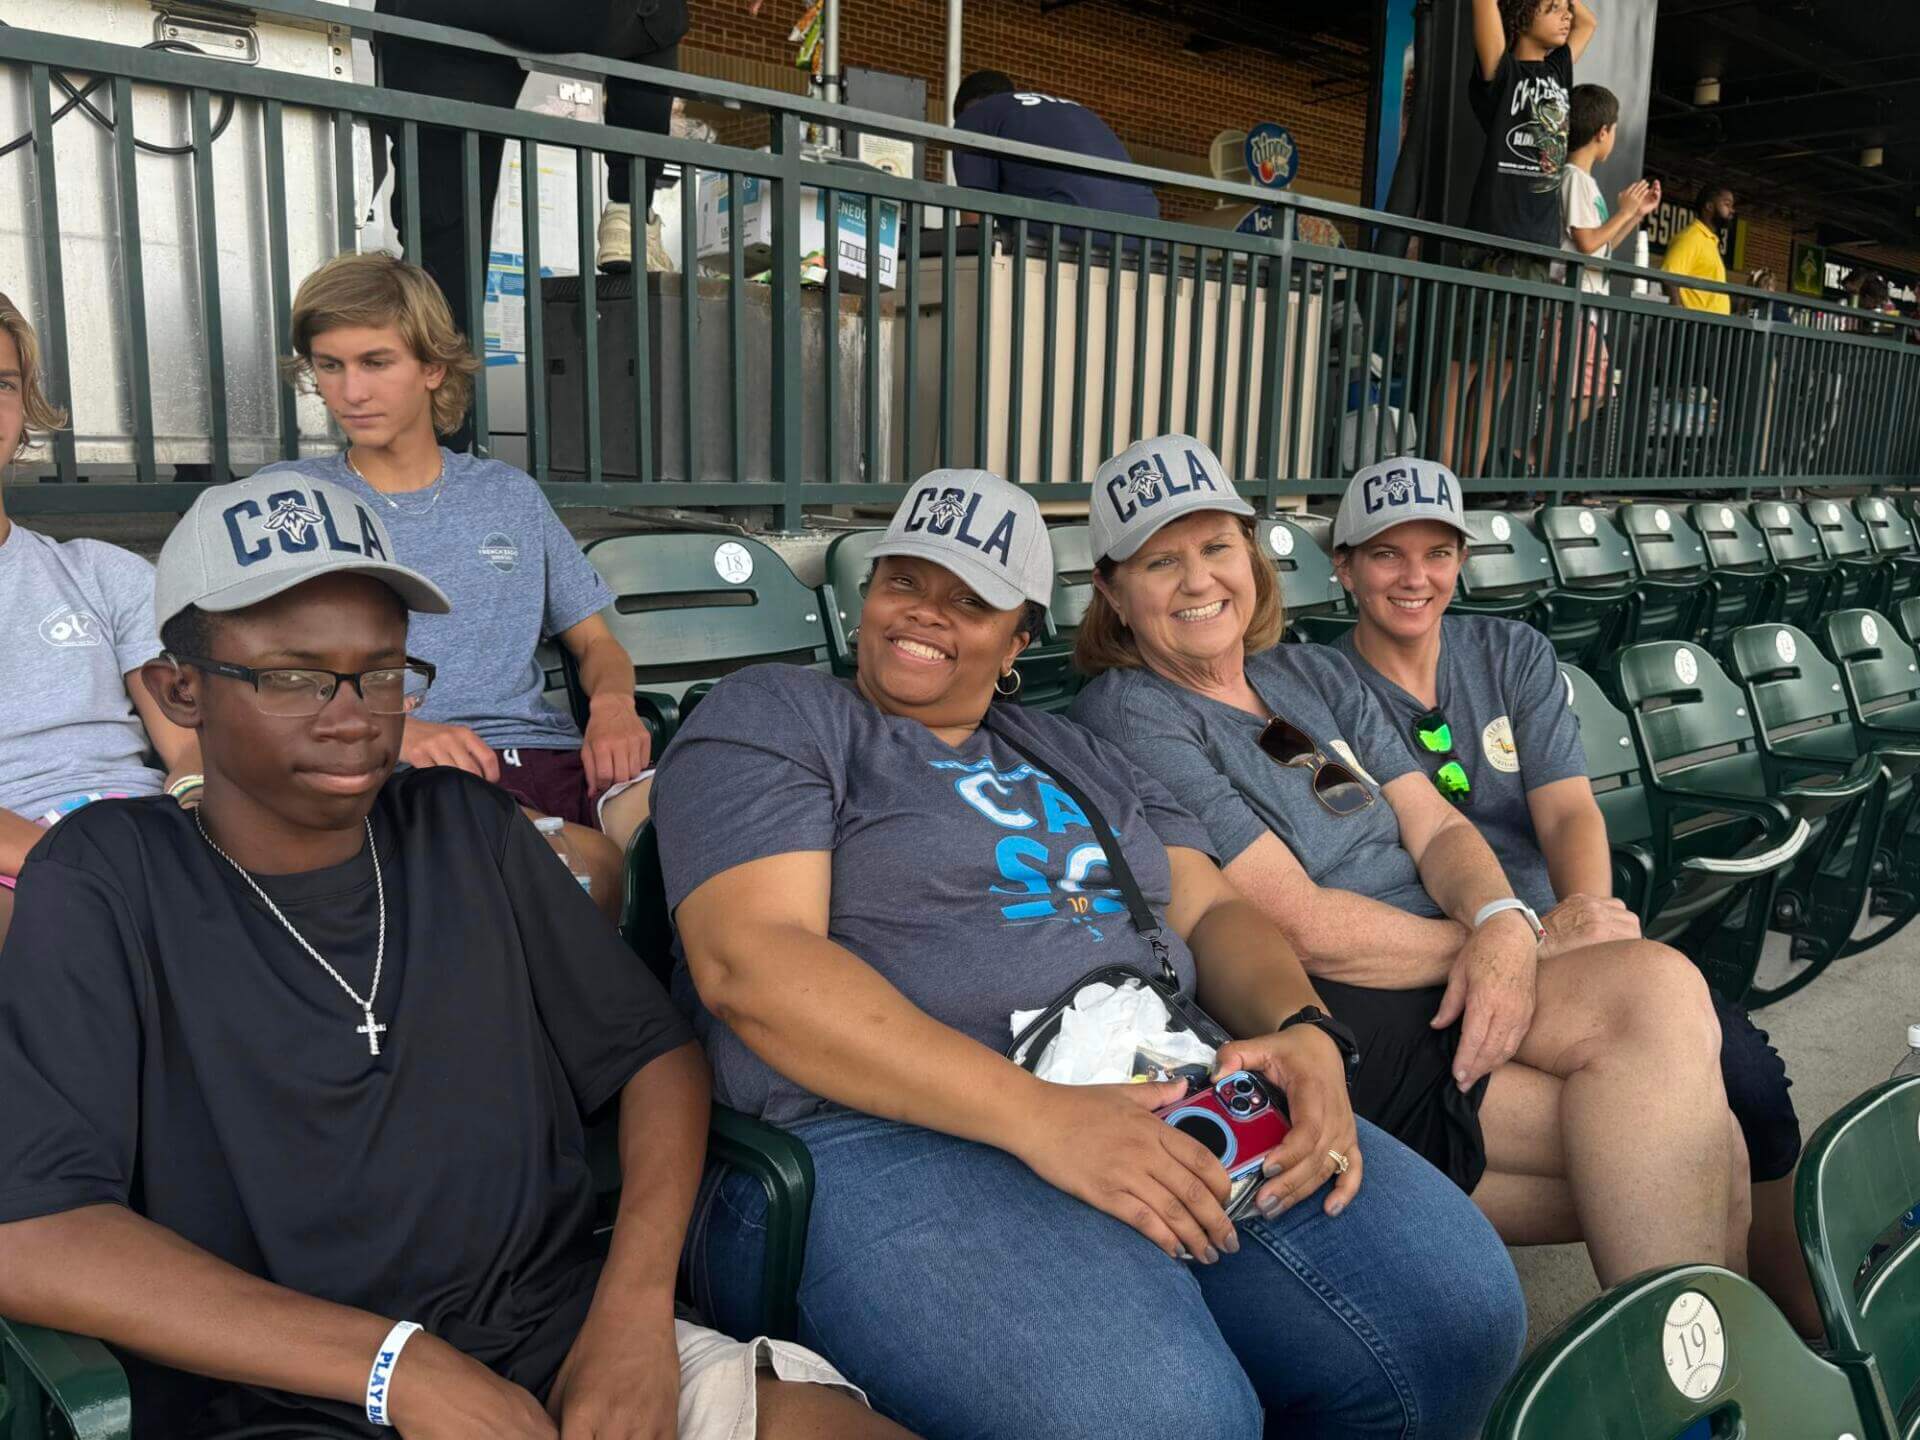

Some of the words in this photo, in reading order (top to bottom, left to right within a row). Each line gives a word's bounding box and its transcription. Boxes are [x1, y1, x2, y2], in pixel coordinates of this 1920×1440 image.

[1106, 450, 1217, 524] COLA
[1363, 467, 1455, 515] COLA
[222, 489, 387, 567] COLA
[904, 487, 1017, 567] COLA
[726, 555, 743, 571] 18
[1679, 1322, 1707, 1370] 19
[370, 1351, 394, 1402] PLAY
